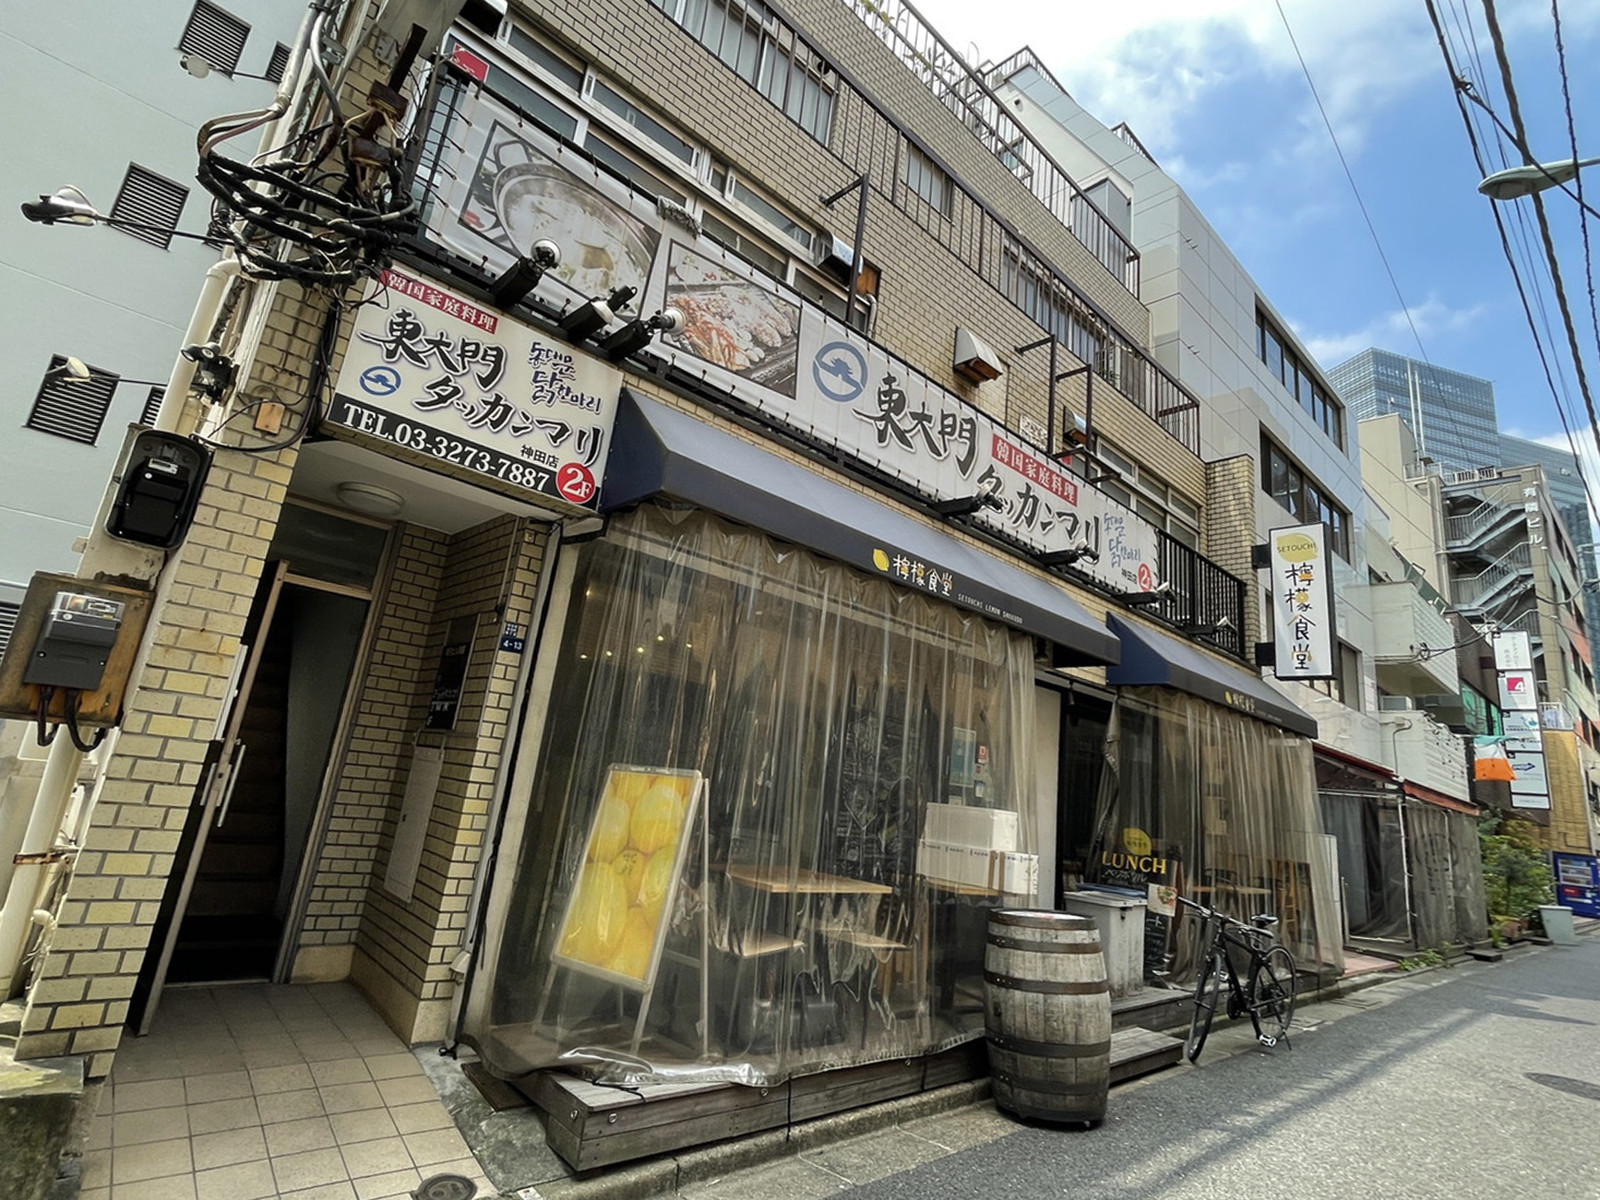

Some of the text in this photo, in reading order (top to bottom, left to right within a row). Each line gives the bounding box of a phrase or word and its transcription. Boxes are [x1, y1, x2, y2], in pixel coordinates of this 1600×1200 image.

[388, 273, 496, 333] 韓国家庭料理
[357, 309, 504, 388] 東大門
[414, 375, 602, 465] タッカンマリ
[852, 371, 977, 477] 東大門
[520, 444, 560, 468] 神田店
[995, 439, 1075, 503] 韓国家庭料理
[562, 467, 591, 497] 2F
[1277, 542, 1316, 553] SETOUCHI
[893, 554, 953, 597] 檸檬食堂
[1285, 562, 1316, 669] 檸檬食堂
[503, 640, 522, 650] 4-13
[1102, 851, 1167, 874] LUNCH
